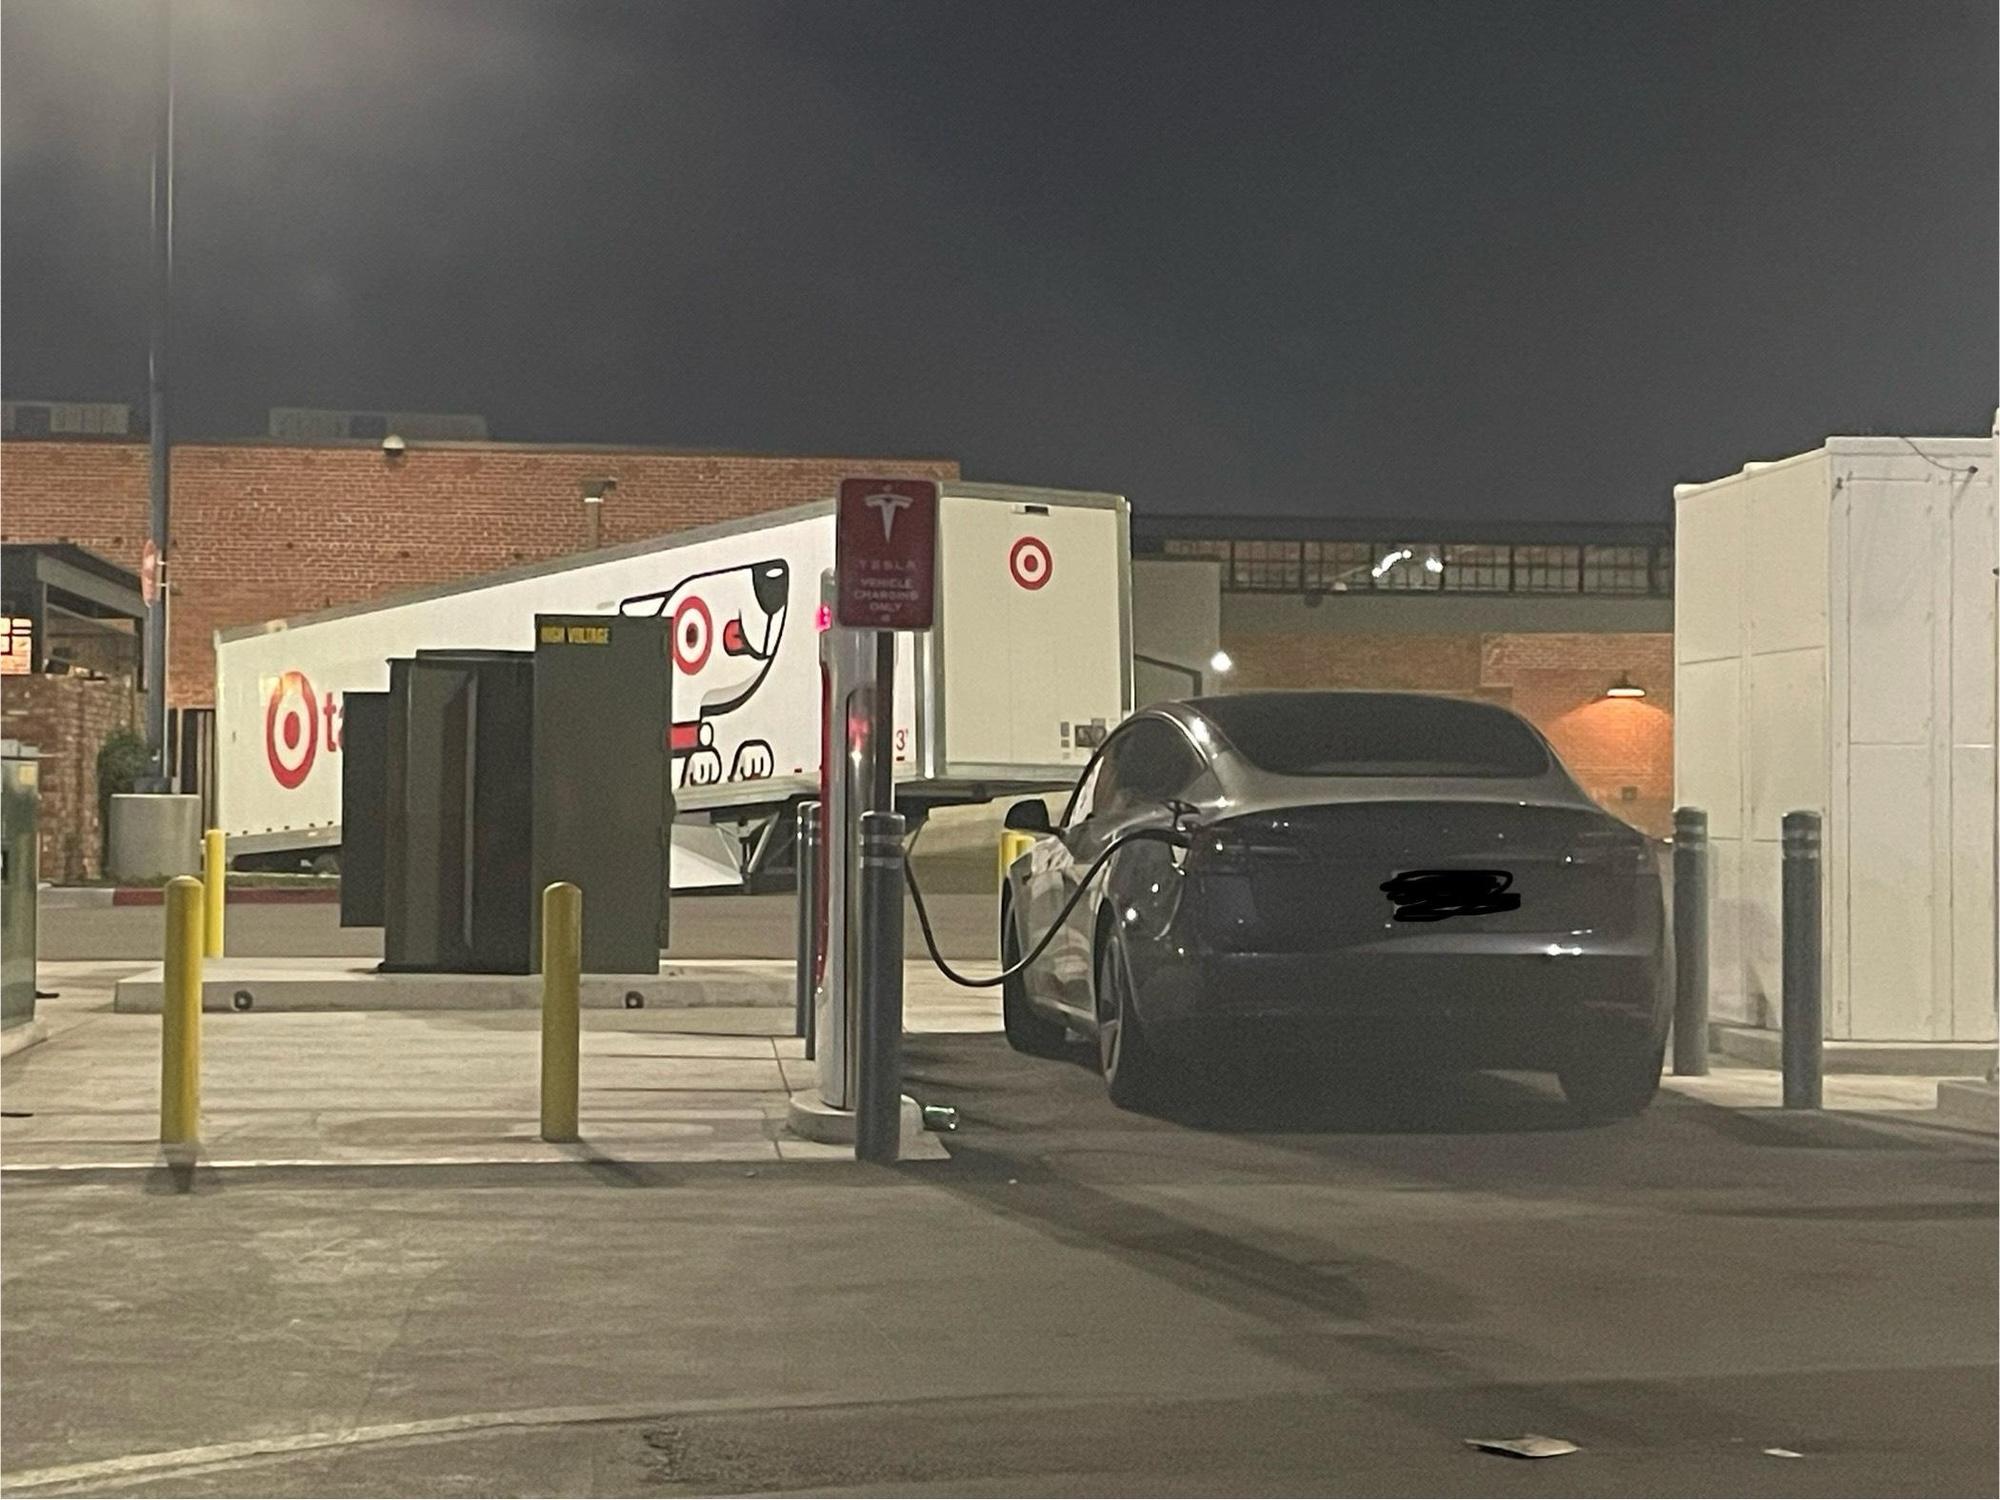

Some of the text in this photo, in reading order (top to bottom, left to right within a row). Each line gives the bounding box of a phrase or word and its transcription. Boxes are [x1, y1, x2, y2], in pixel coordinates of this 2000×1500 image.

[859, 559, 917, 570] TESLA
[860, 578, 914, 589] VEHICLE
[854, 590, 919, 601] CHARGING
[869, 602, 903, 613] ONLY
[541, 626, 610, 644] HIGH VOLTAGE
